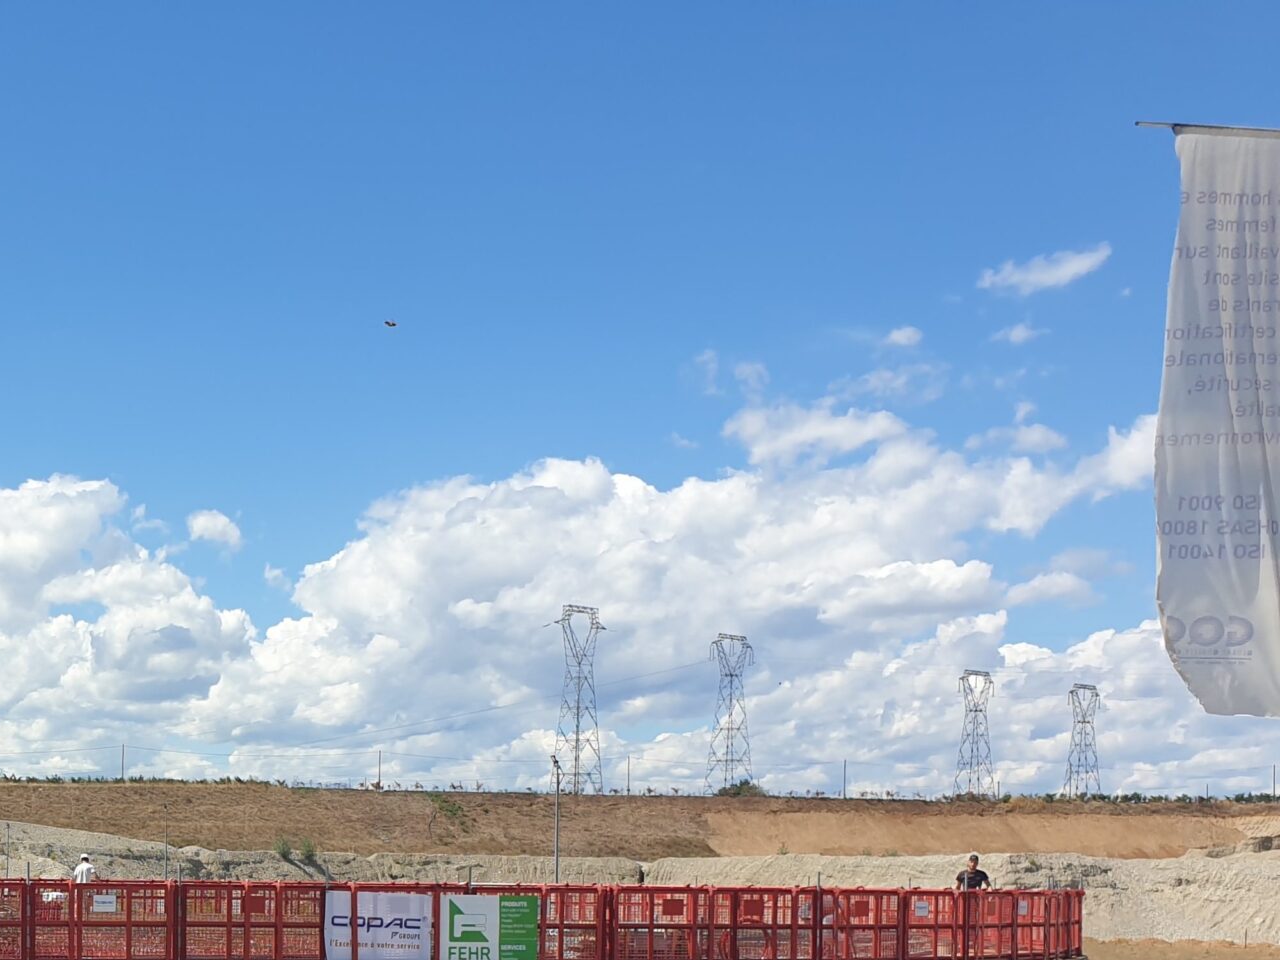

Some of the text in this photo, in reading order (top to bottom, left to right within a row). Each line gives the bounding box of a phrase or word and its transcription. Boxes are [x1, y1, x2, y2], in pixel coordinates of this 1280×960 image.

[330, 938, 368, 948] l'Excelnce
[376, 941, 395, 949] votre
[448, 946, 491, 960] FEHR
